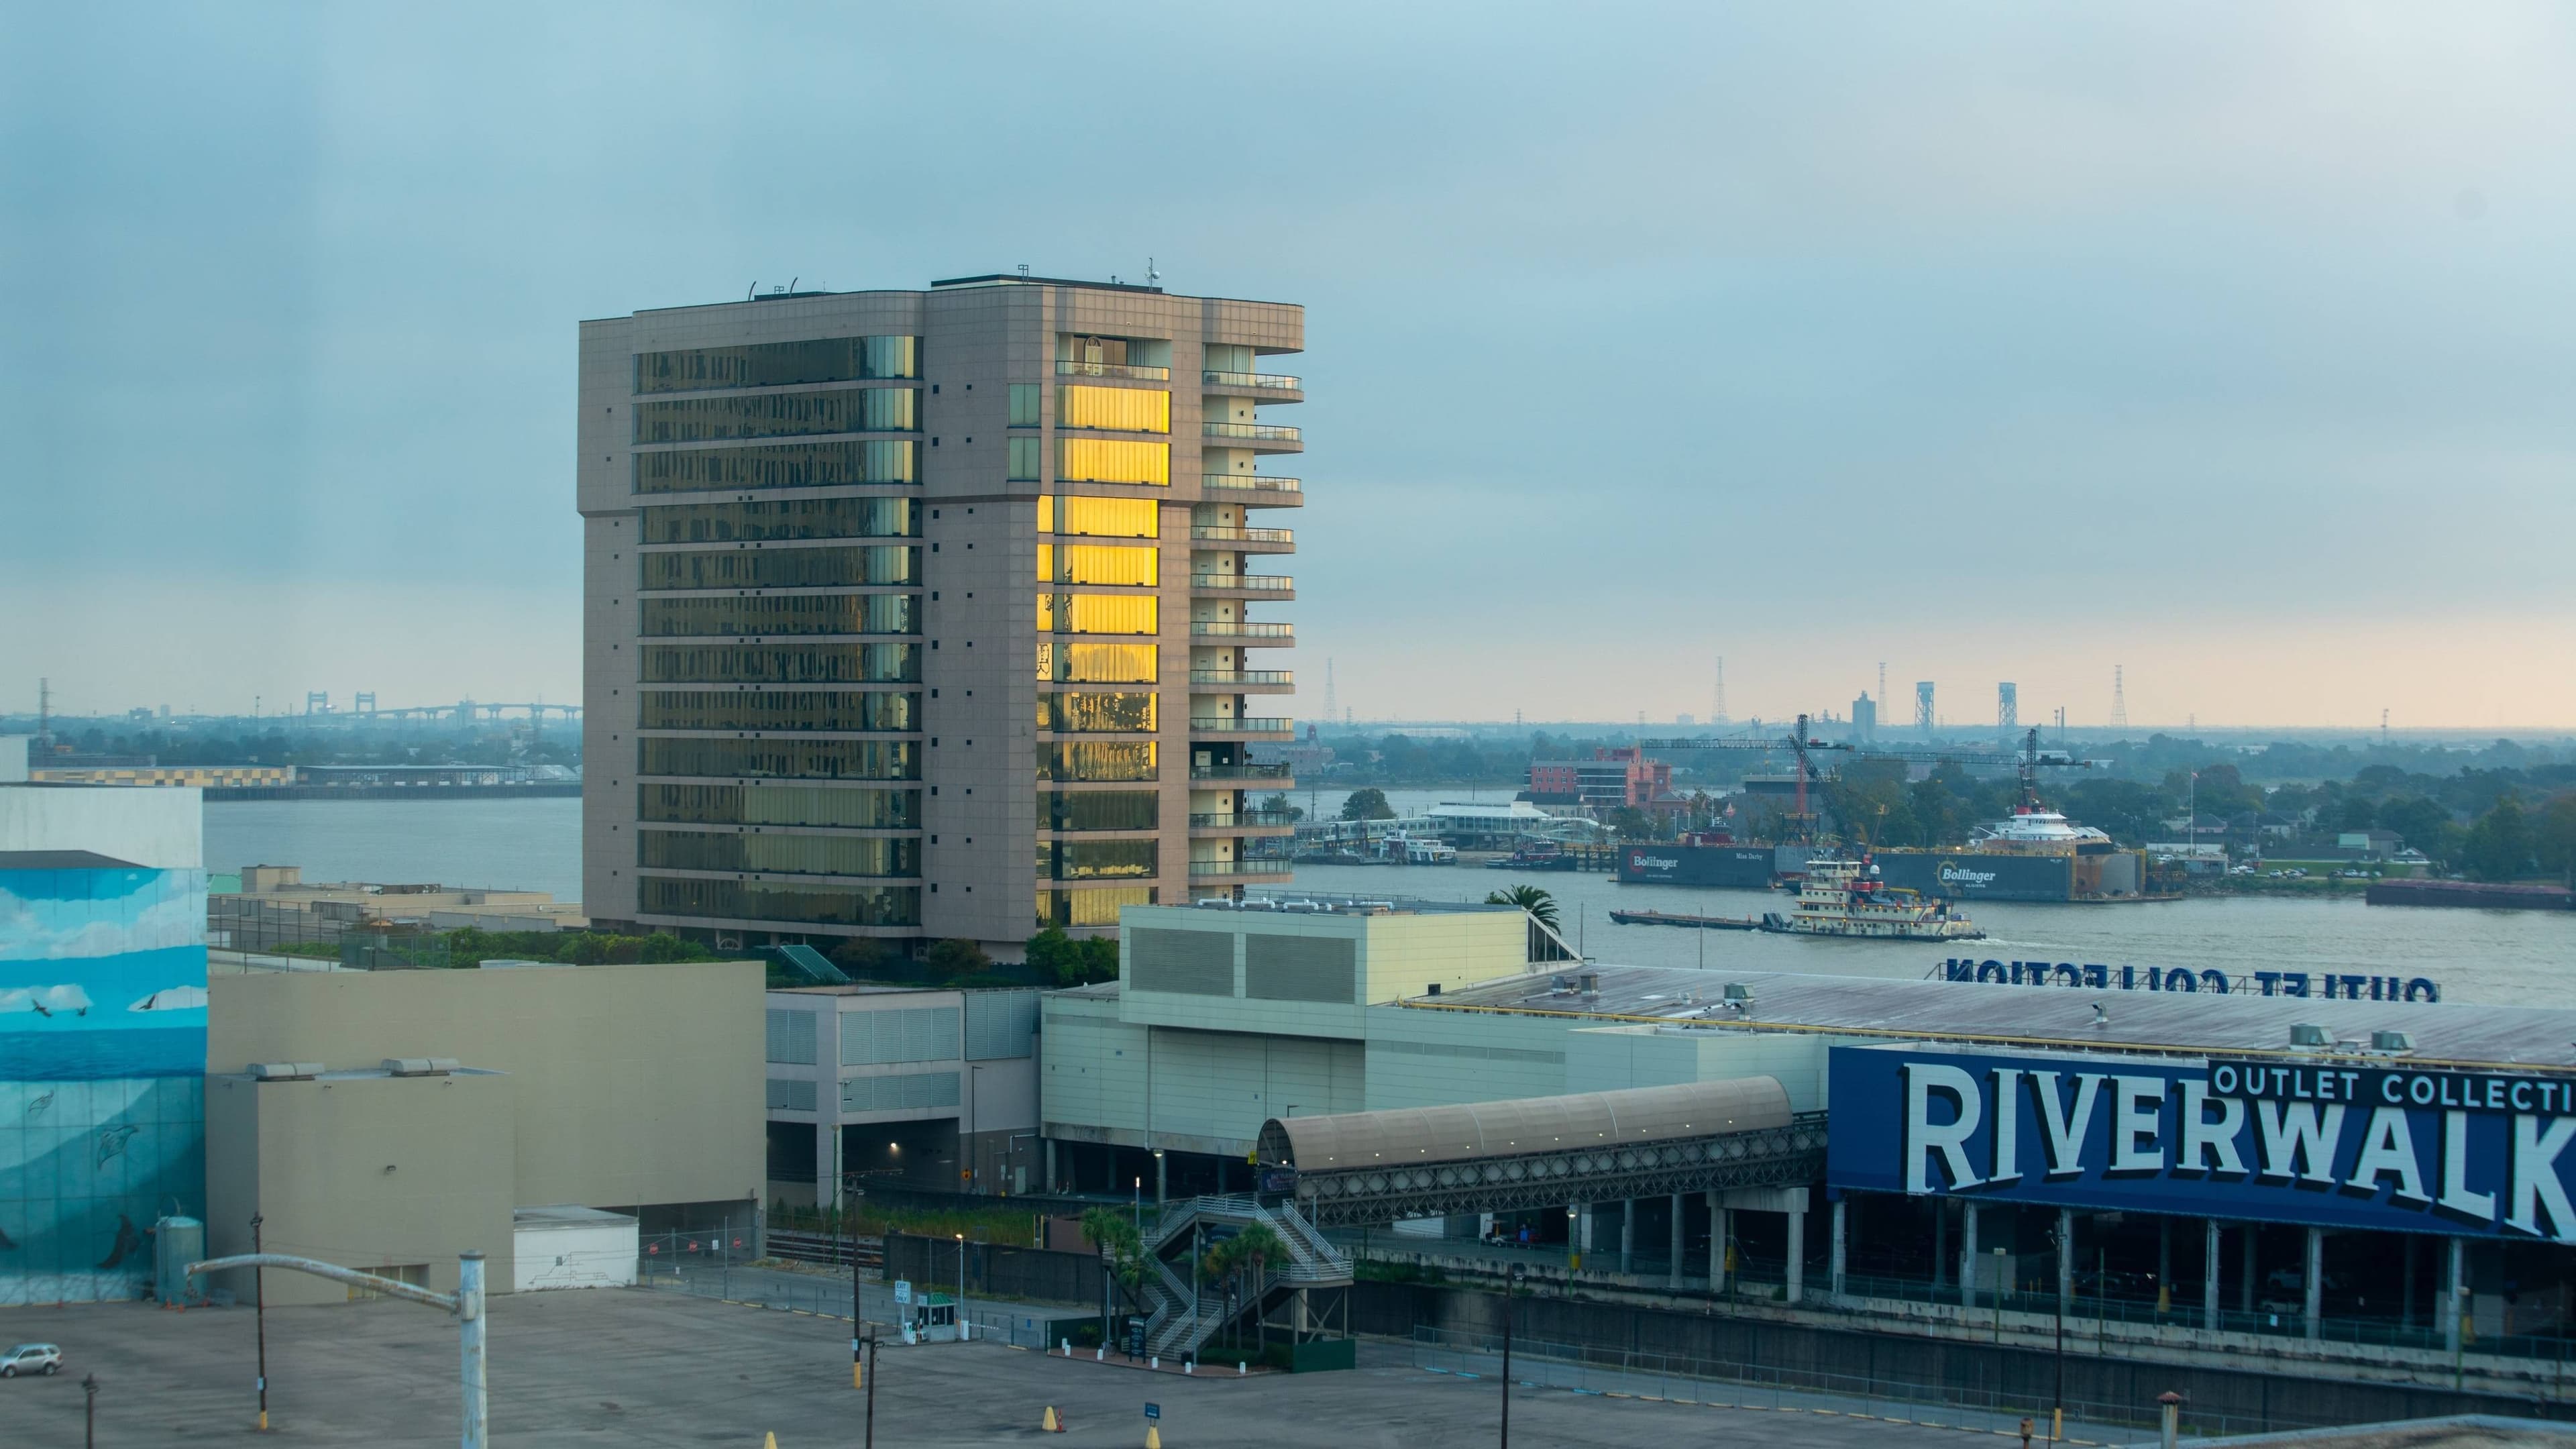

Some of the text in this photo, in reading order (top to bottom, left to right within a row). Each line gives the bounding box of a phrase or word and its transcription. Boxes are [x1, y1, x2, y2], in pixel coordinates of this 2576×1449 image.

[1633, 855, 1678, 870] Bollinger
[1942, 868, 1996, 883] Bollinger
[2214, 1065, 2359, 1101] OUTLET
[1904, 1062, 2576, 1246] RIVERWALK
